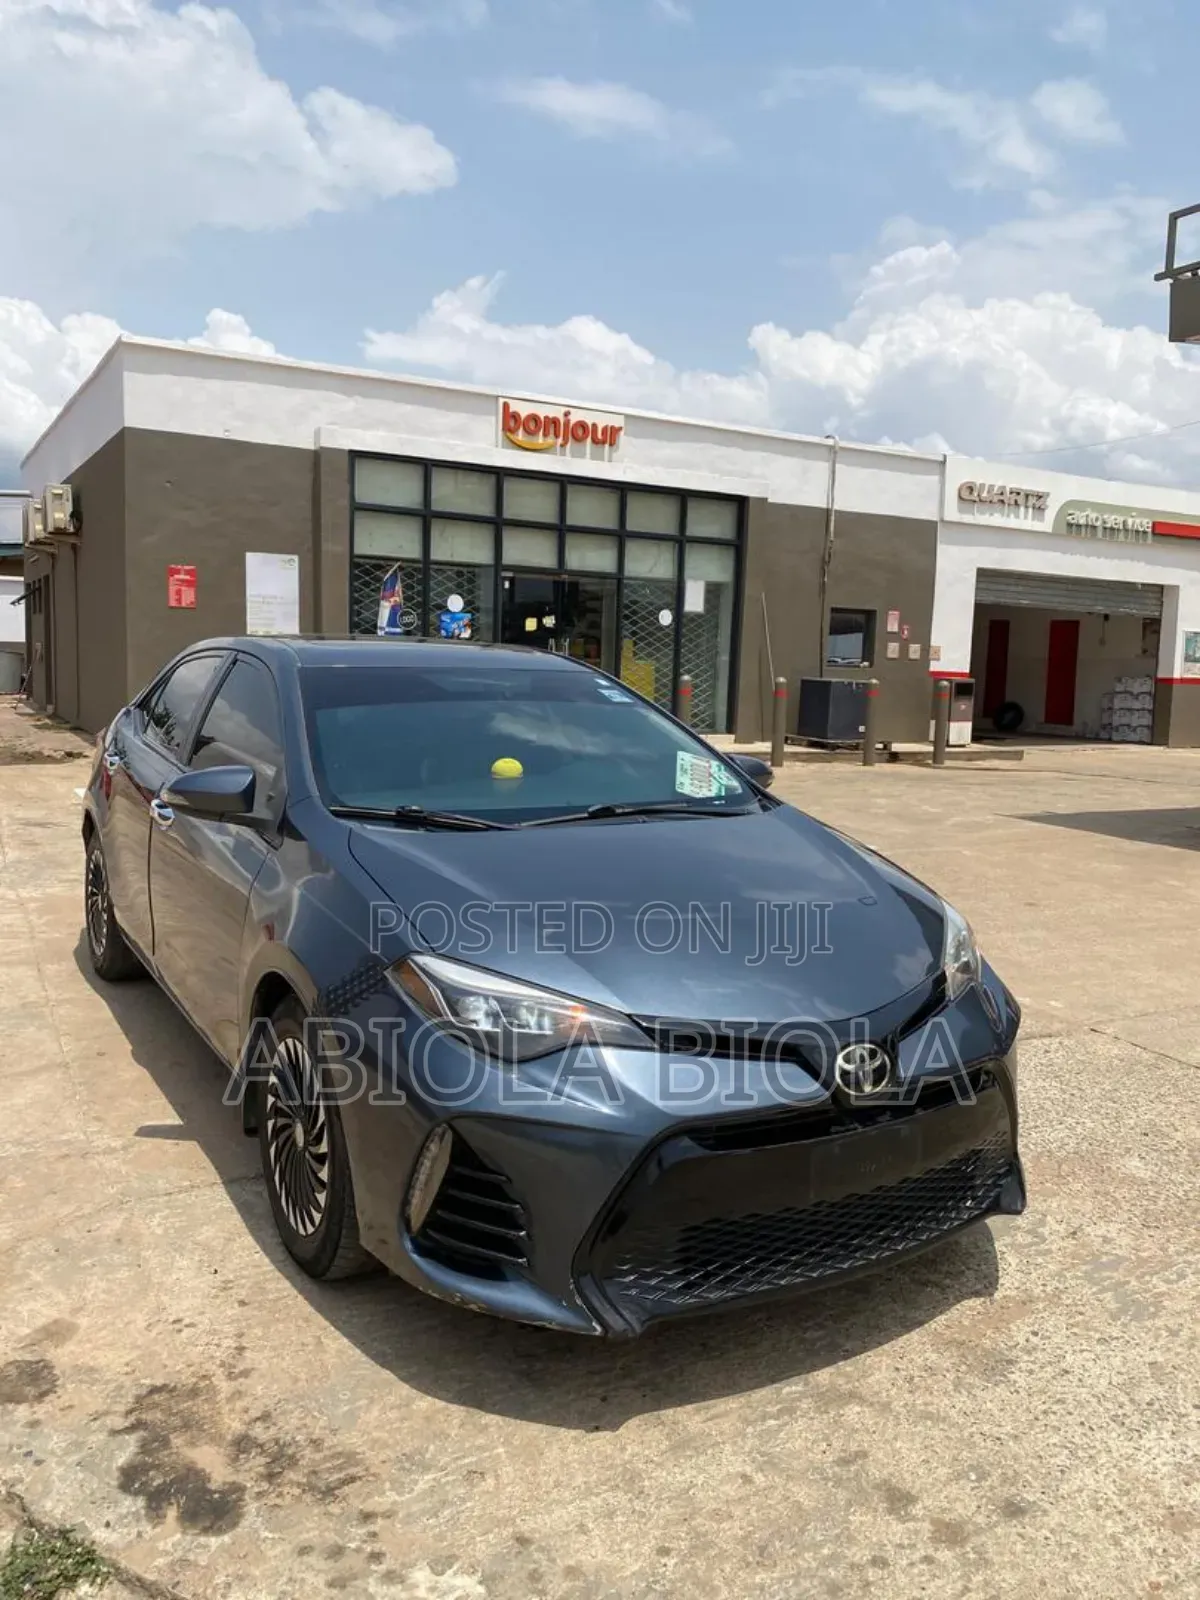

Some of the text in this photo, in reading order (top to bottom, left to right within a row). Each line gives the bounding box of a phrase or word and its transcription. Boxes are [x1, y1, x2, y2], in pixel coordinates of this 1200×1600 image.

[502, 401, 622, 447] bonjour
[958, 481, 1050, 511] QUARTZ
[1066, 507, 1152, 531] auto service
